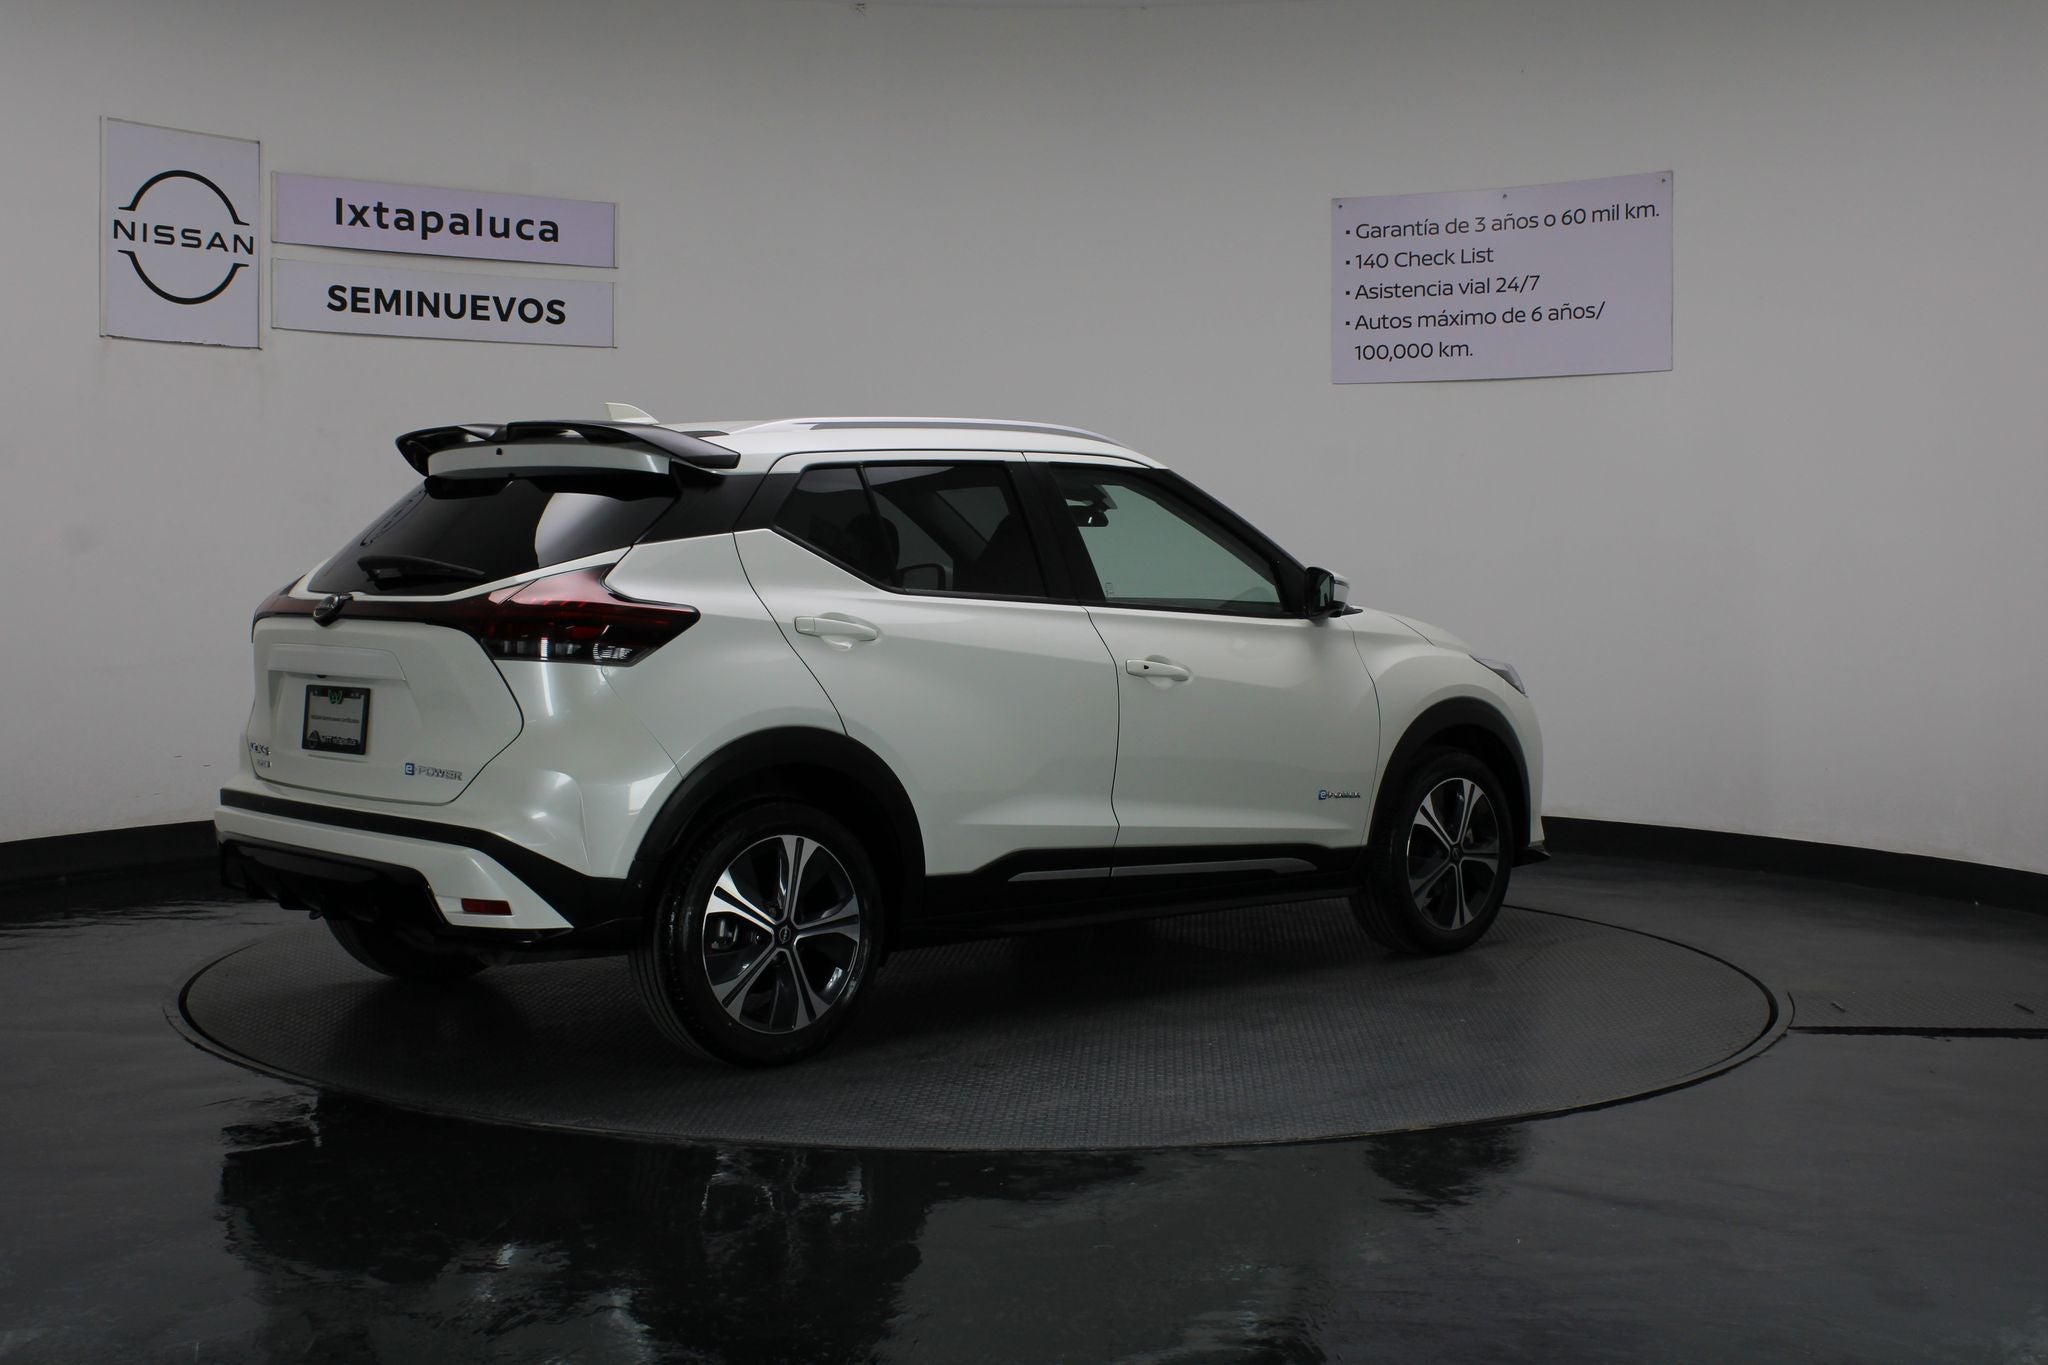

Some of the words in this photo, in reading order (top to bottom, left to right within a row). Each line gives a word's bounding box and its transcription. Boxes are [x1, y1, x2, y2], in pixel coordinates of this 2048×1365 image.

[114, 218, 255, 256] NISSAN
[335, 197, 560, 243] Ixtapaluca
[1355, 218, 1440, 240] Garantía
[1445, 217, 1470, 235] de
[1474, 216, 1487, 233] 3
[1491, 212, 1540, 232] años
[1544, 213, 1557, 228] o
[1562, 208, 1587, 226] 60
[1591, 203, 1620, 224] mil
[1625, 202, 1660, 221] km.
[1355, 252, 1389, 270] 140
[1394, 248, 1456, 268] Check
[1461, 247, 1495, 265] List
[1355, 280, 1454, 301] Asistencia
[1458, 277, 1491, 296] vial
[1496, 274, 1541, 294] 24/7
[327, 284, 567, 326] SEMINUEVOS
[1355, 313, 1413, 331] Autos
[1418, 309, 1497, 329] máximo
[1502, 306, 1527, 324] de
[1531, 305, 1543, 323] 6
[1548, 301, 1606, 322] años/
[1355, 342, 1434, 363] 100,000
[1438, 341, 1474, 358] km.
